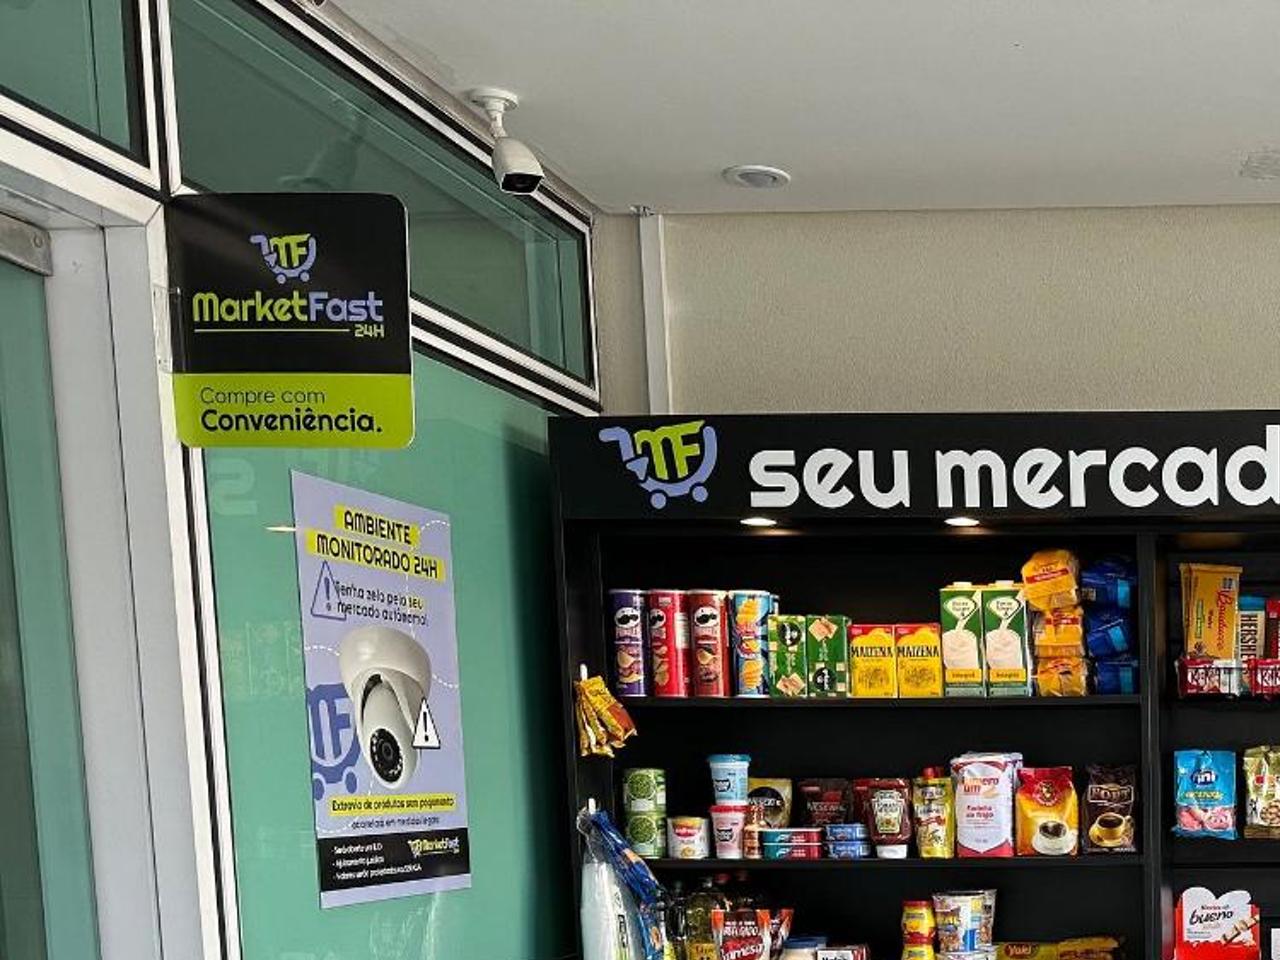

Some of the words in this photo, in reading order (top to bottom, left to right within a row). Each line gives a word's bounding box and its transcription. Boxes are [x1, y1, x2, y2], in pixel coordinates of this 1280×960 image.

[193, 292, 384, 322] MarketFast
[354, 324, 385, 338] 24H
[200, 387, 276, 406] Compre
[281, 388, 326, 404] com
[200, 408, 383, 434] Conveniência.
[748, 447, 910, 509] seu
[344, 510, 412, 544] AMBIENTE
[317, 534, 410, 572] MONITORADO
[414, 556, 438, 579] 24H
[851, 646, 894, 658] MAIZENA
[897, 645, 939, 658] MAIZENA
[1189, 909, 1234, 926] bueno
